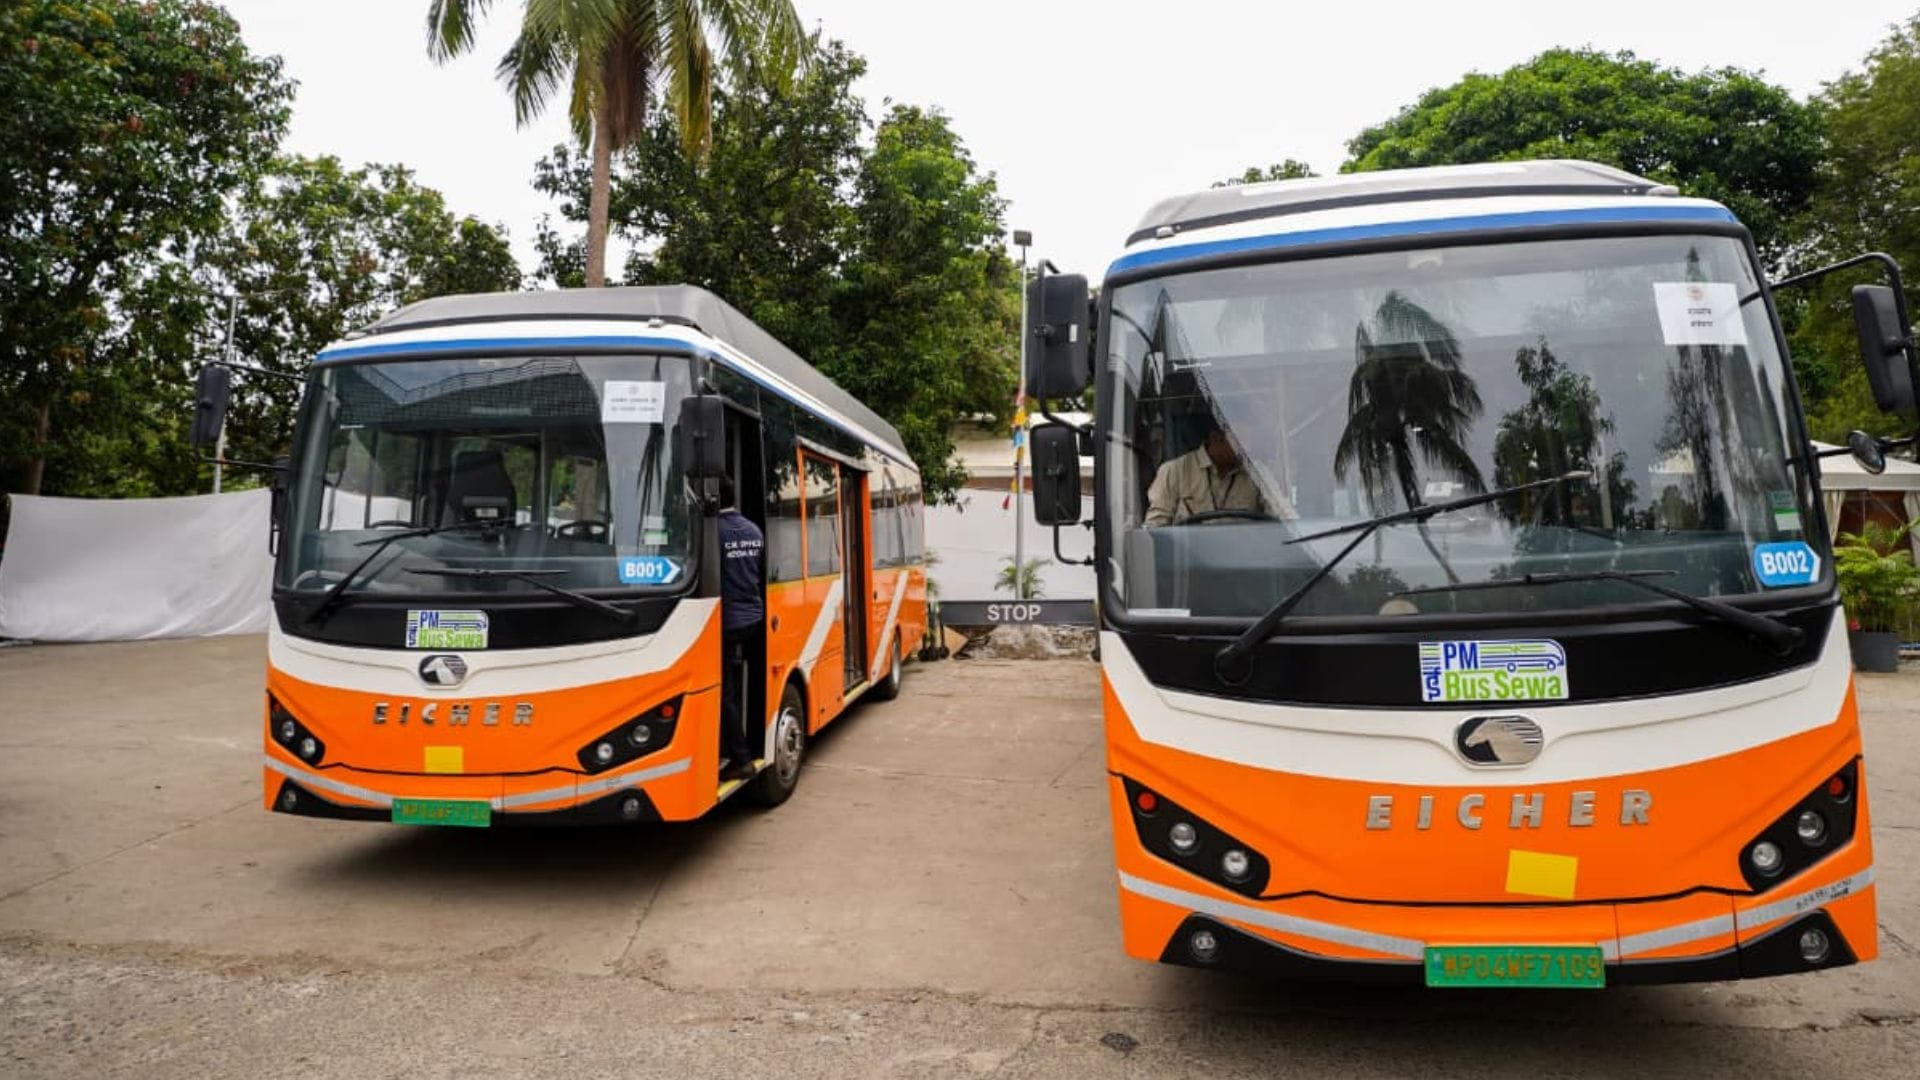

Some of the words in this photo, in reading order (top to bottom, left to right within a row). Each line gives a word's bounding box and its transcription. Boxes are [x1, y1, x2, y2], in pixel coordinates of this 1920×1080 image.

[625, 562, 663, 578] B001
[1761, 550, 1809, 575] B002
[420, 611, 439, 629] PM
[987, 604, 1041, 622] STOP
[1442, 641, 1479, 670] PM
[373, 702, 534, 725] EICHER
[1366, 789, 1653, 829] EICHER
[1444, 953, 1600, 981] MP04WF7109
